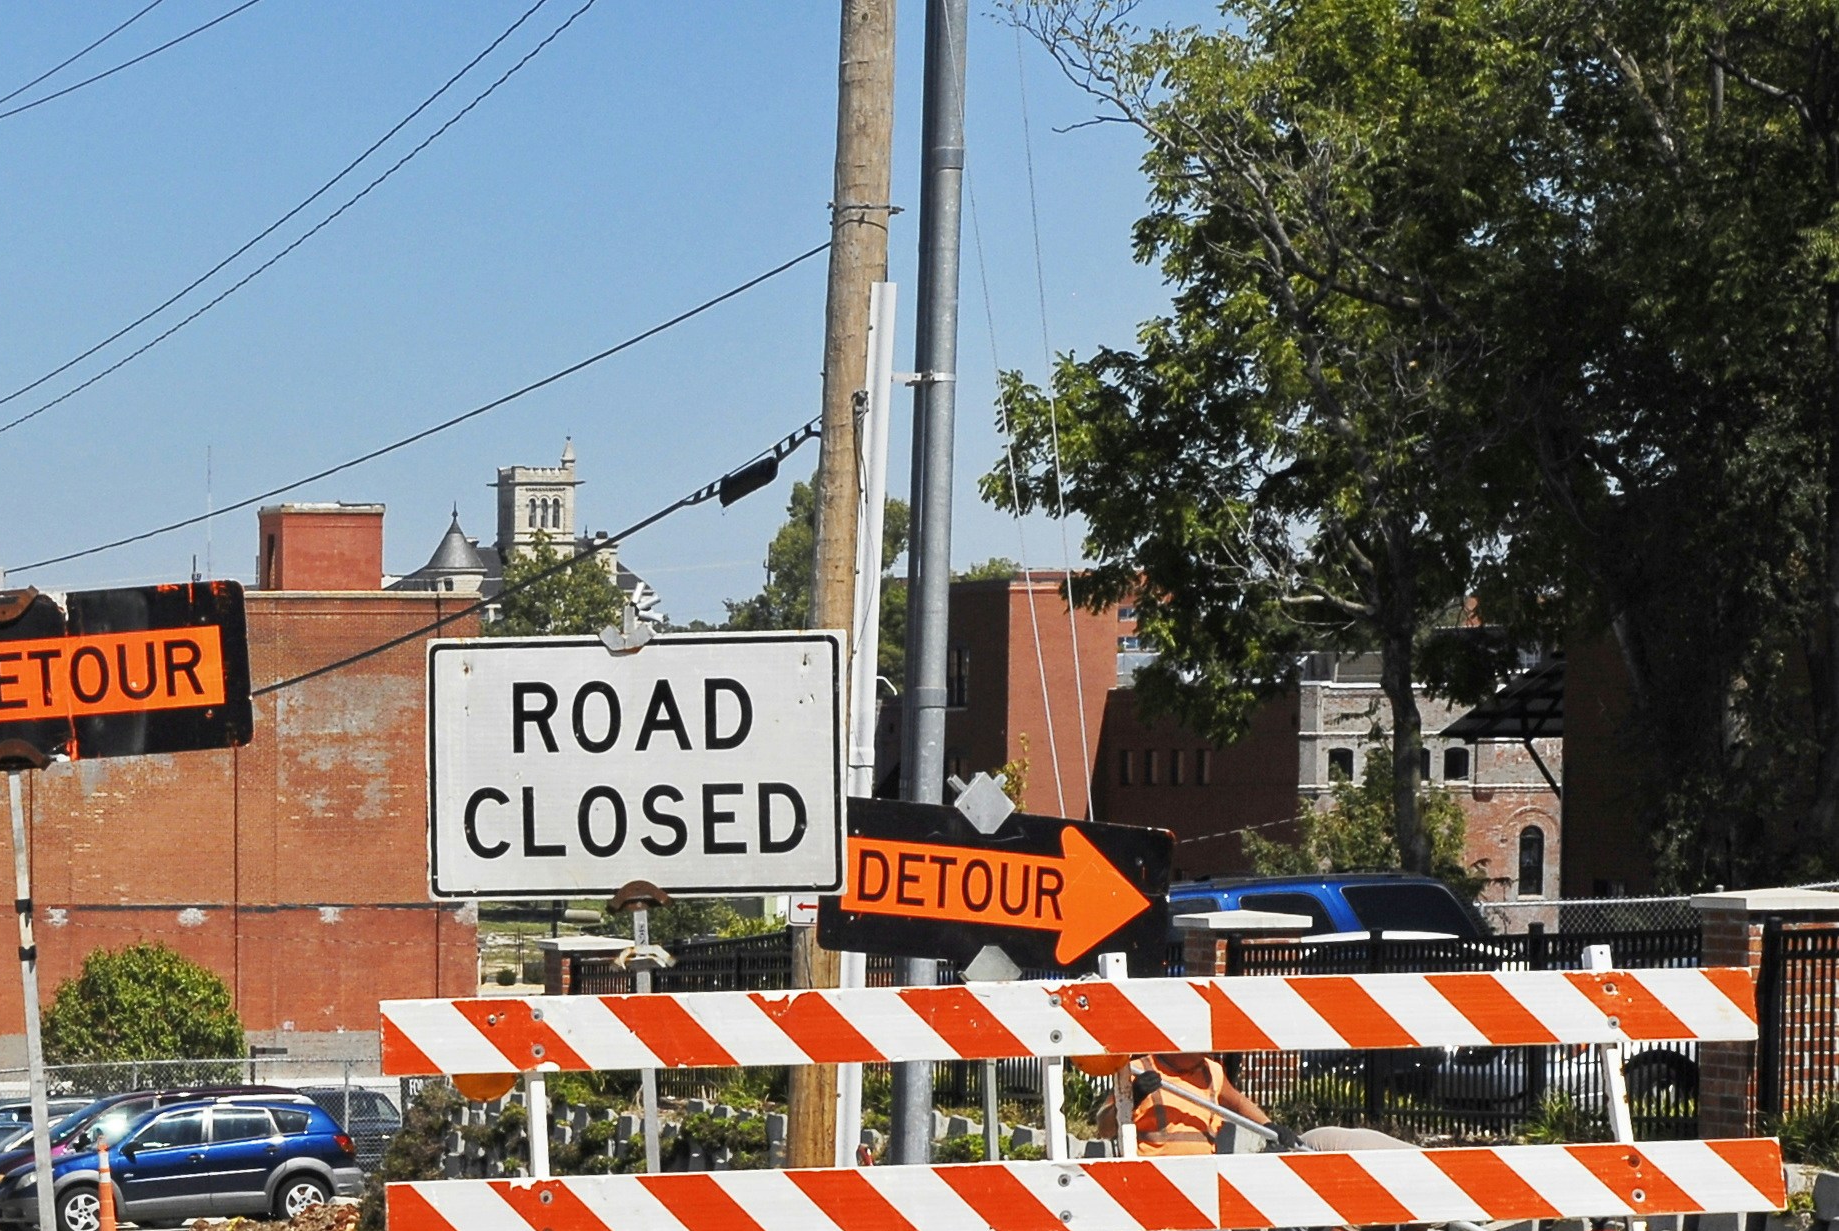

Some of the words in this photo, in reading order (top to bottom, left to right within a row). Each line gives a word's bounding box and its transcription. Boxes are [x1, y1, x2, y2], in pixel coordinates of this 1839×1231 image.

[513, 679, 753, 754] ROAD
[464, 782, 808, 858] CLOSED
[857, 849, 1065, 921] DETOUR
